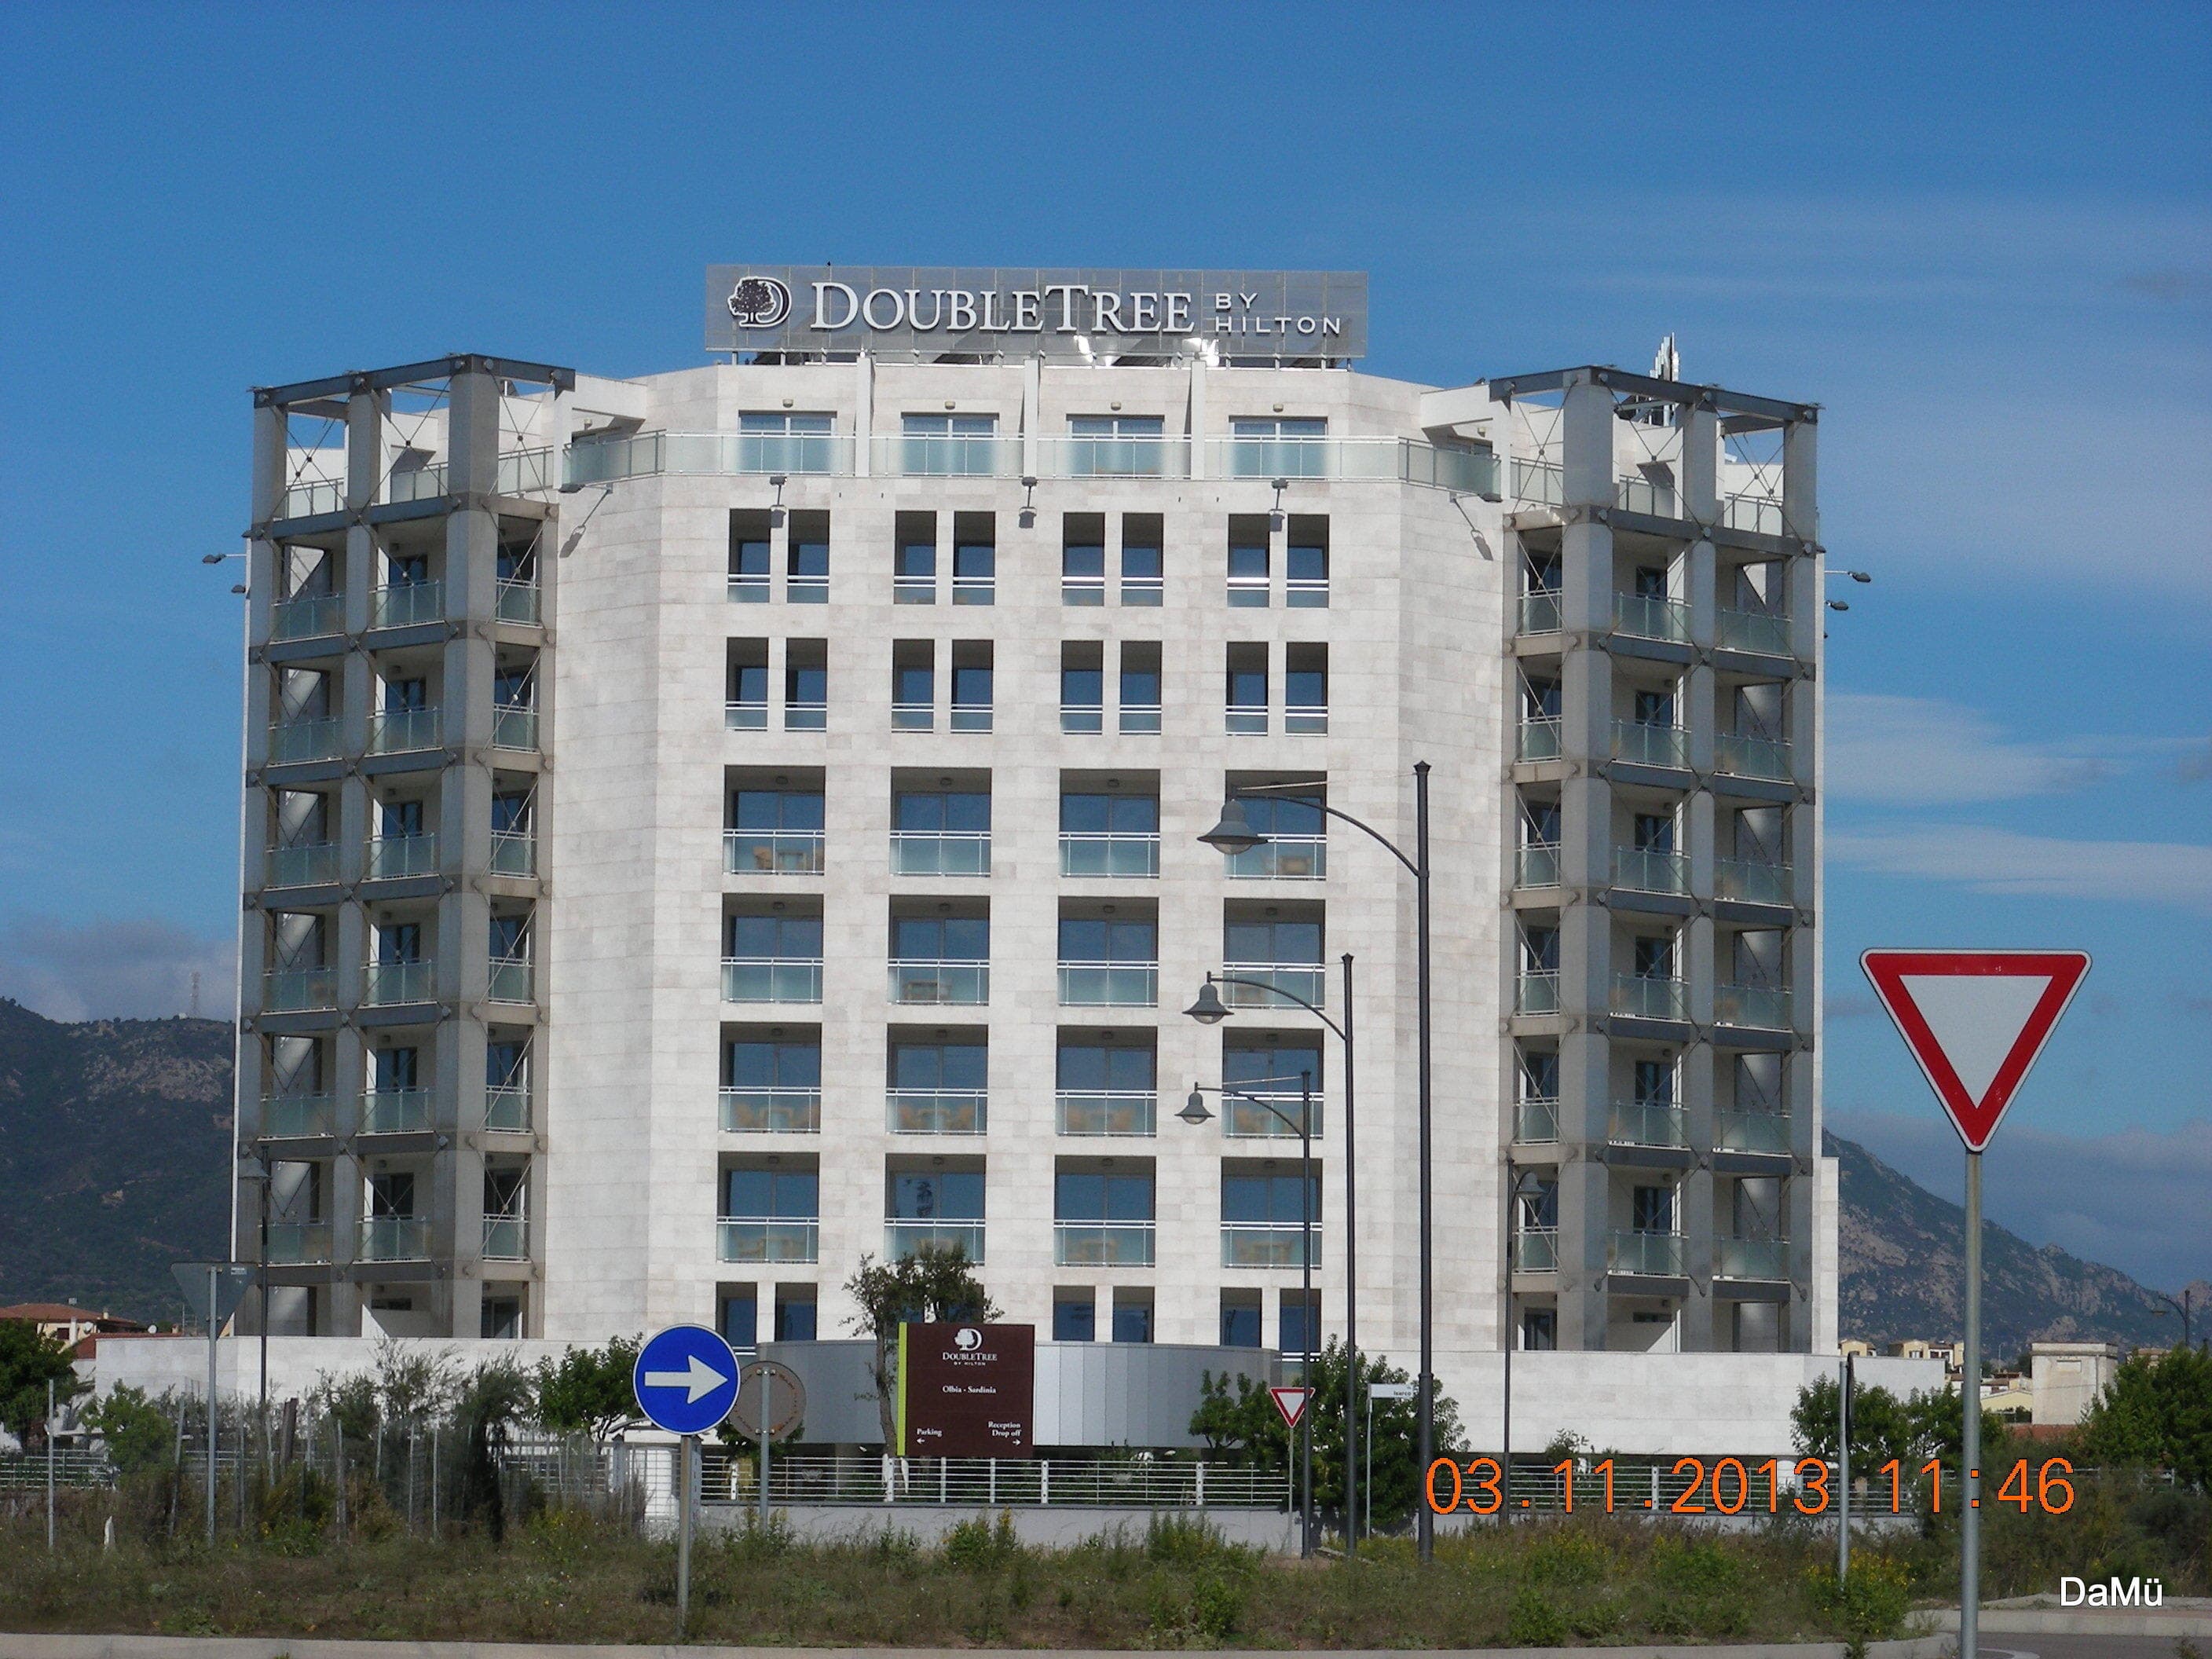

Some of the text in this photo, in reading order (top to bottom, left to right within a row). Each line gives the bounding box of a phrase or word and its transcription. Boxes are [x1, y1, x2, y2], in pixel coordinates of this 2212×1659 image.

[1215, 293, 1258, 309] BY
[1215, 316, 1340, 335] HILTON
[988, 1421, 1021, 1430] Reception
[917, 1428, 943, 1437] Parking
